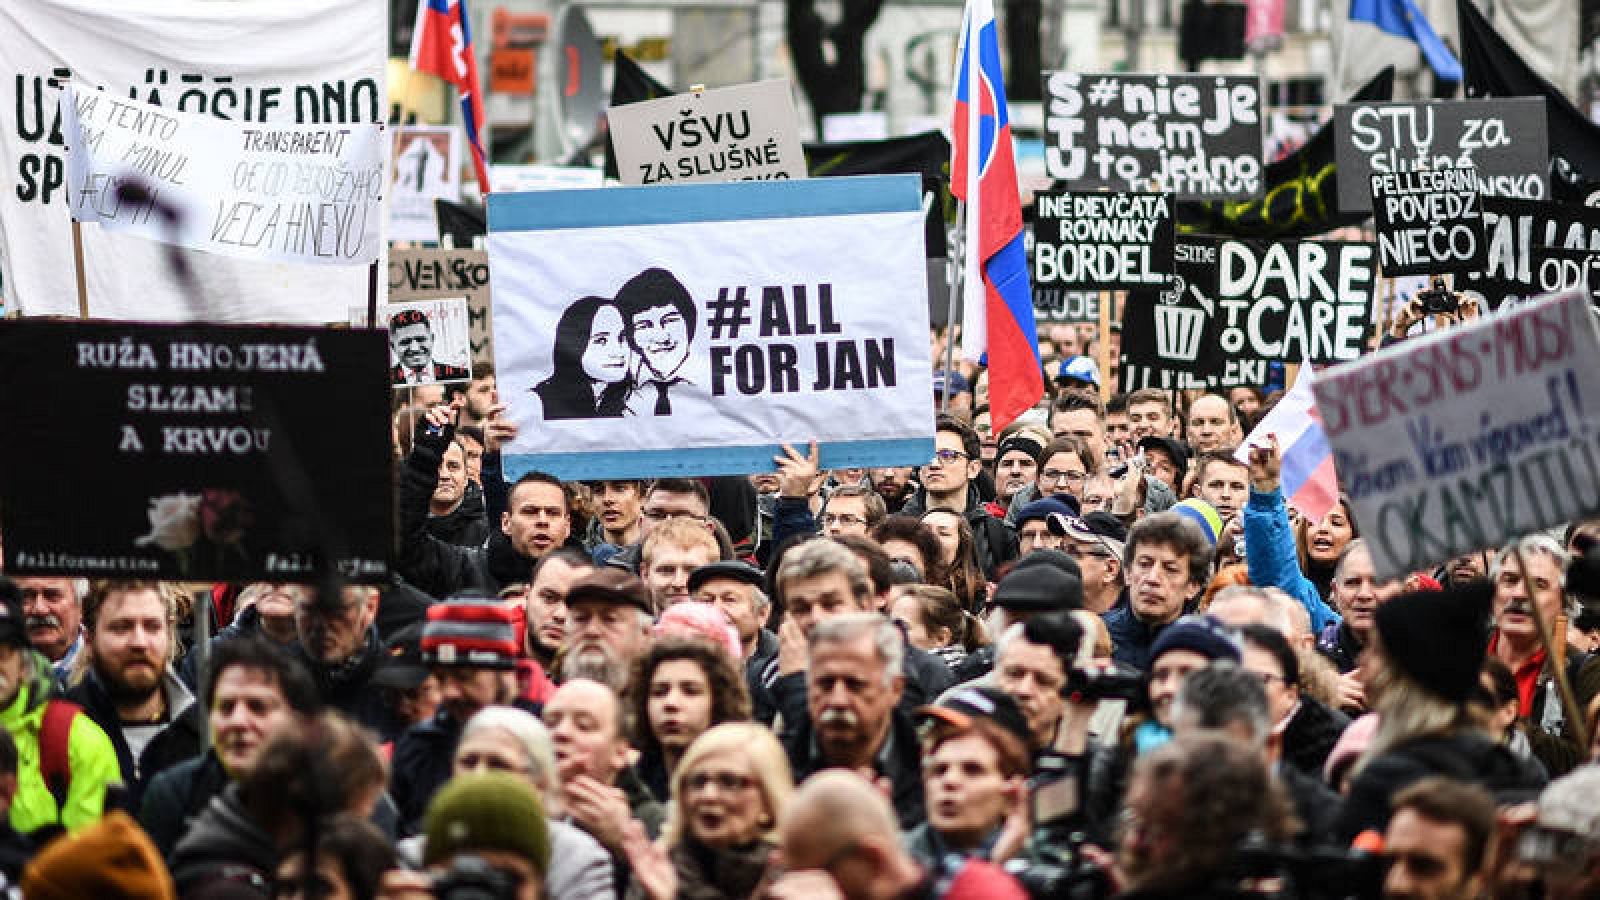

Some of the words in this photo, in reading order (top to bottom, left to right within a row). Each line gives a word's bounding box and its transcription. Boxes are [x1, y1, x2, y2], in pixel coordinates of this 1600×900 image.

[109, 101, 179, 140] TENTO
[1203, 76, 1259, 135] je
[1351, 105, 1435, 152] STU
[1459, 118, 1511, 149] za
[242, 129, 350, 158] TRANSPARENT
[652, 109, 751, 152] VŠVU
[639, 161, 673, 185] ZA
[677, 137, 780, 177] SLUŠNÉ
[1091, 148, 1141, 181] to
[284, 199, 370, 258] HNEVU
[1038, 191, 1073, 219] INÉ
[1385, 191, 1480, 225] POVEDZ
[1379, 221, 1477, 268] NIEČO
[1219, 241, 1373, 303] DARE
[706, 283, 842, 340] #ALL
[1249, 296, 1367, 360] CARE
[77, 336, 157, 369] RUŽA
[169, 337, 325, 372] HNOJENÁ
[709, 343, 800, 396] FOR
[812, 337, 897, 391] JAN
[119, 425, 142, 451] A
[163, 427, 271, 453] KRVOU
